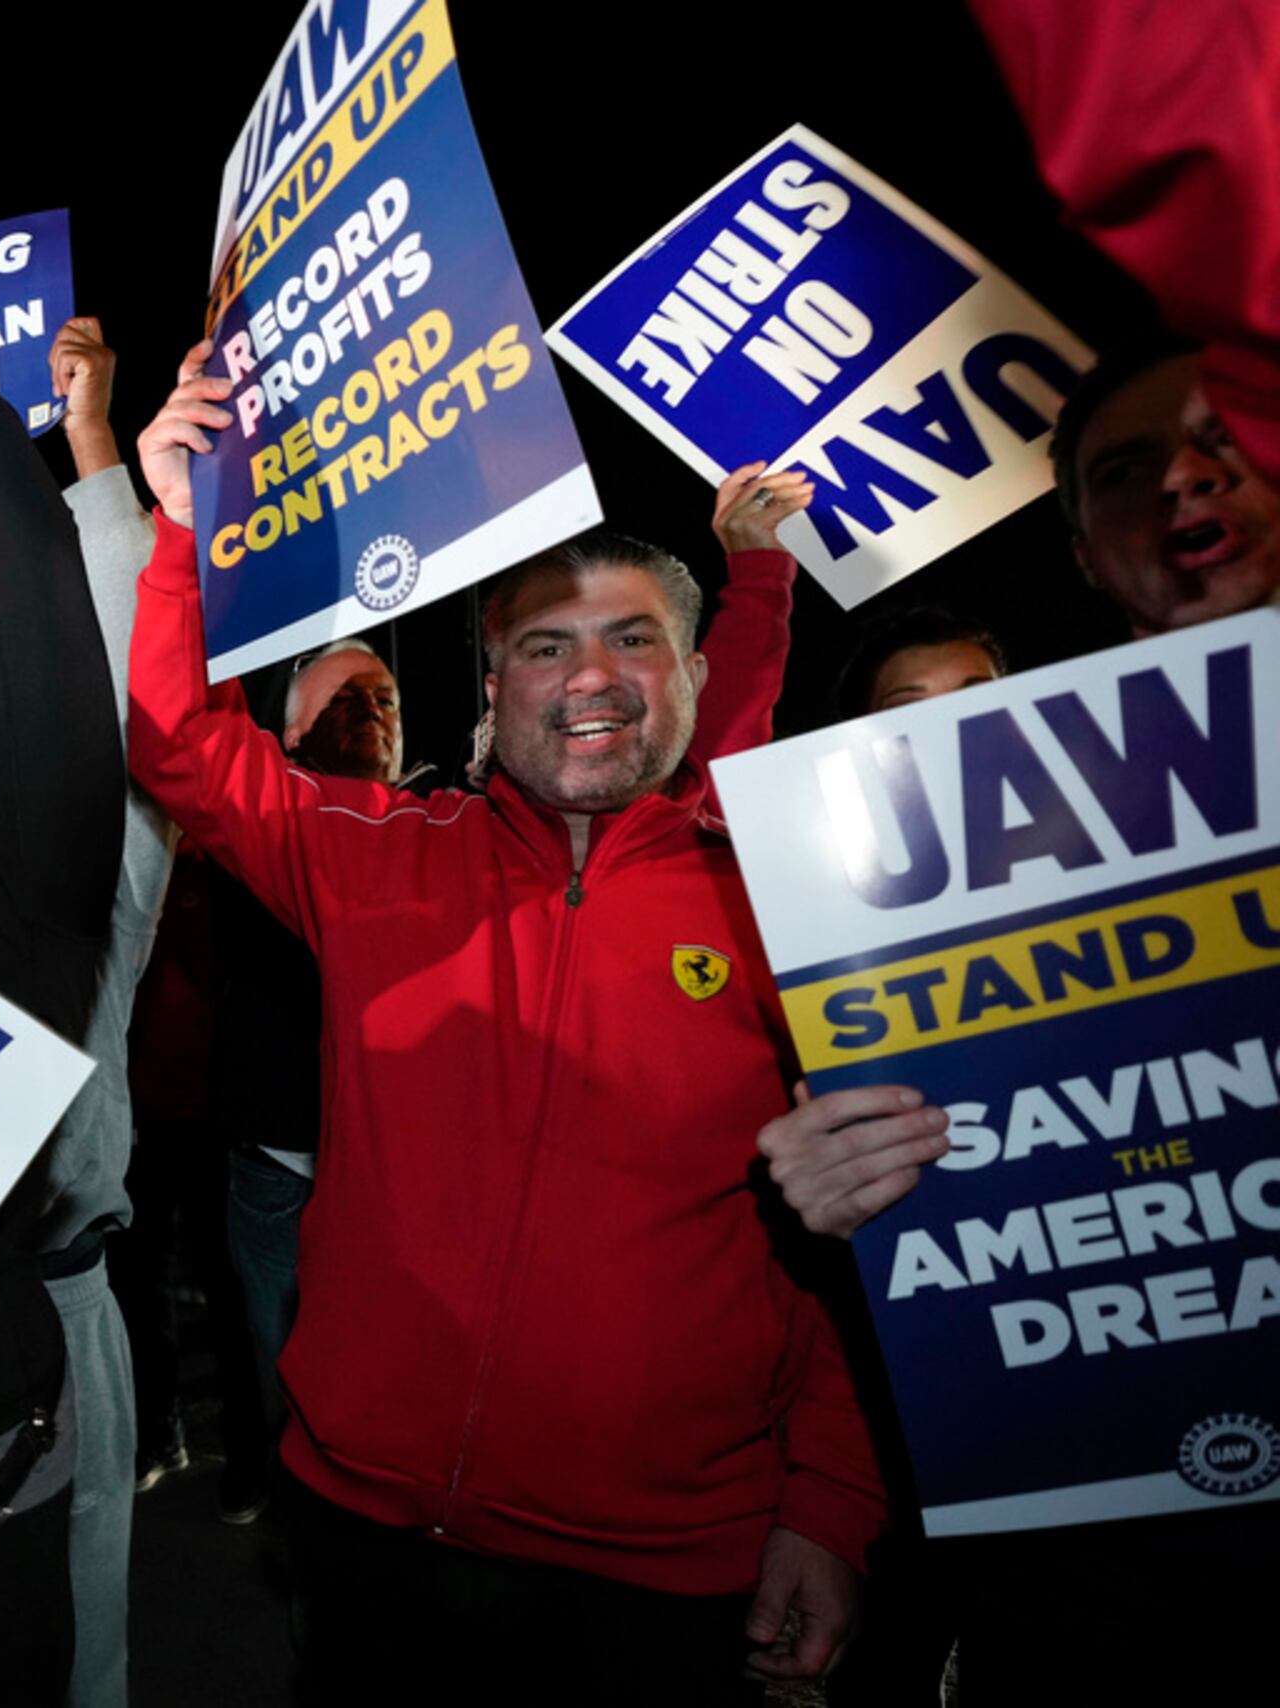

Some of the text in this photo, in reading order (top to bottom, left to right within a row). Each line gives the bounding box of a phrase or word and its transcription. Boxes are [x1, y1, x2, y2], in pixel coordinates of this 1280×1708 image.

[350, 32, 425, 142] UP
[222, 176, 410, 387] RECORD
[236, 232, 432, 439] PROFITS
[616, 159, 851, 408] STRIKE
[741, 279, 873, 406] ON
[209, 323, 531, 570] CONTRACTS
[249, 309, 454, 498] RECORD
[785, 332, 1085, 562] UAW
[816, 643, 1260, 911] UAW
[822, 914, 1197, 1050] STAND
[935, 1038, 1280, 1171] SAVIN
[1112, 1139, 1195, 1177] THE
[887, 1158, 1280, 1300] AMERIC
[990, 1256, 1280, 1369] DREA
[1209, 1443, 1252, 1465] UAW
